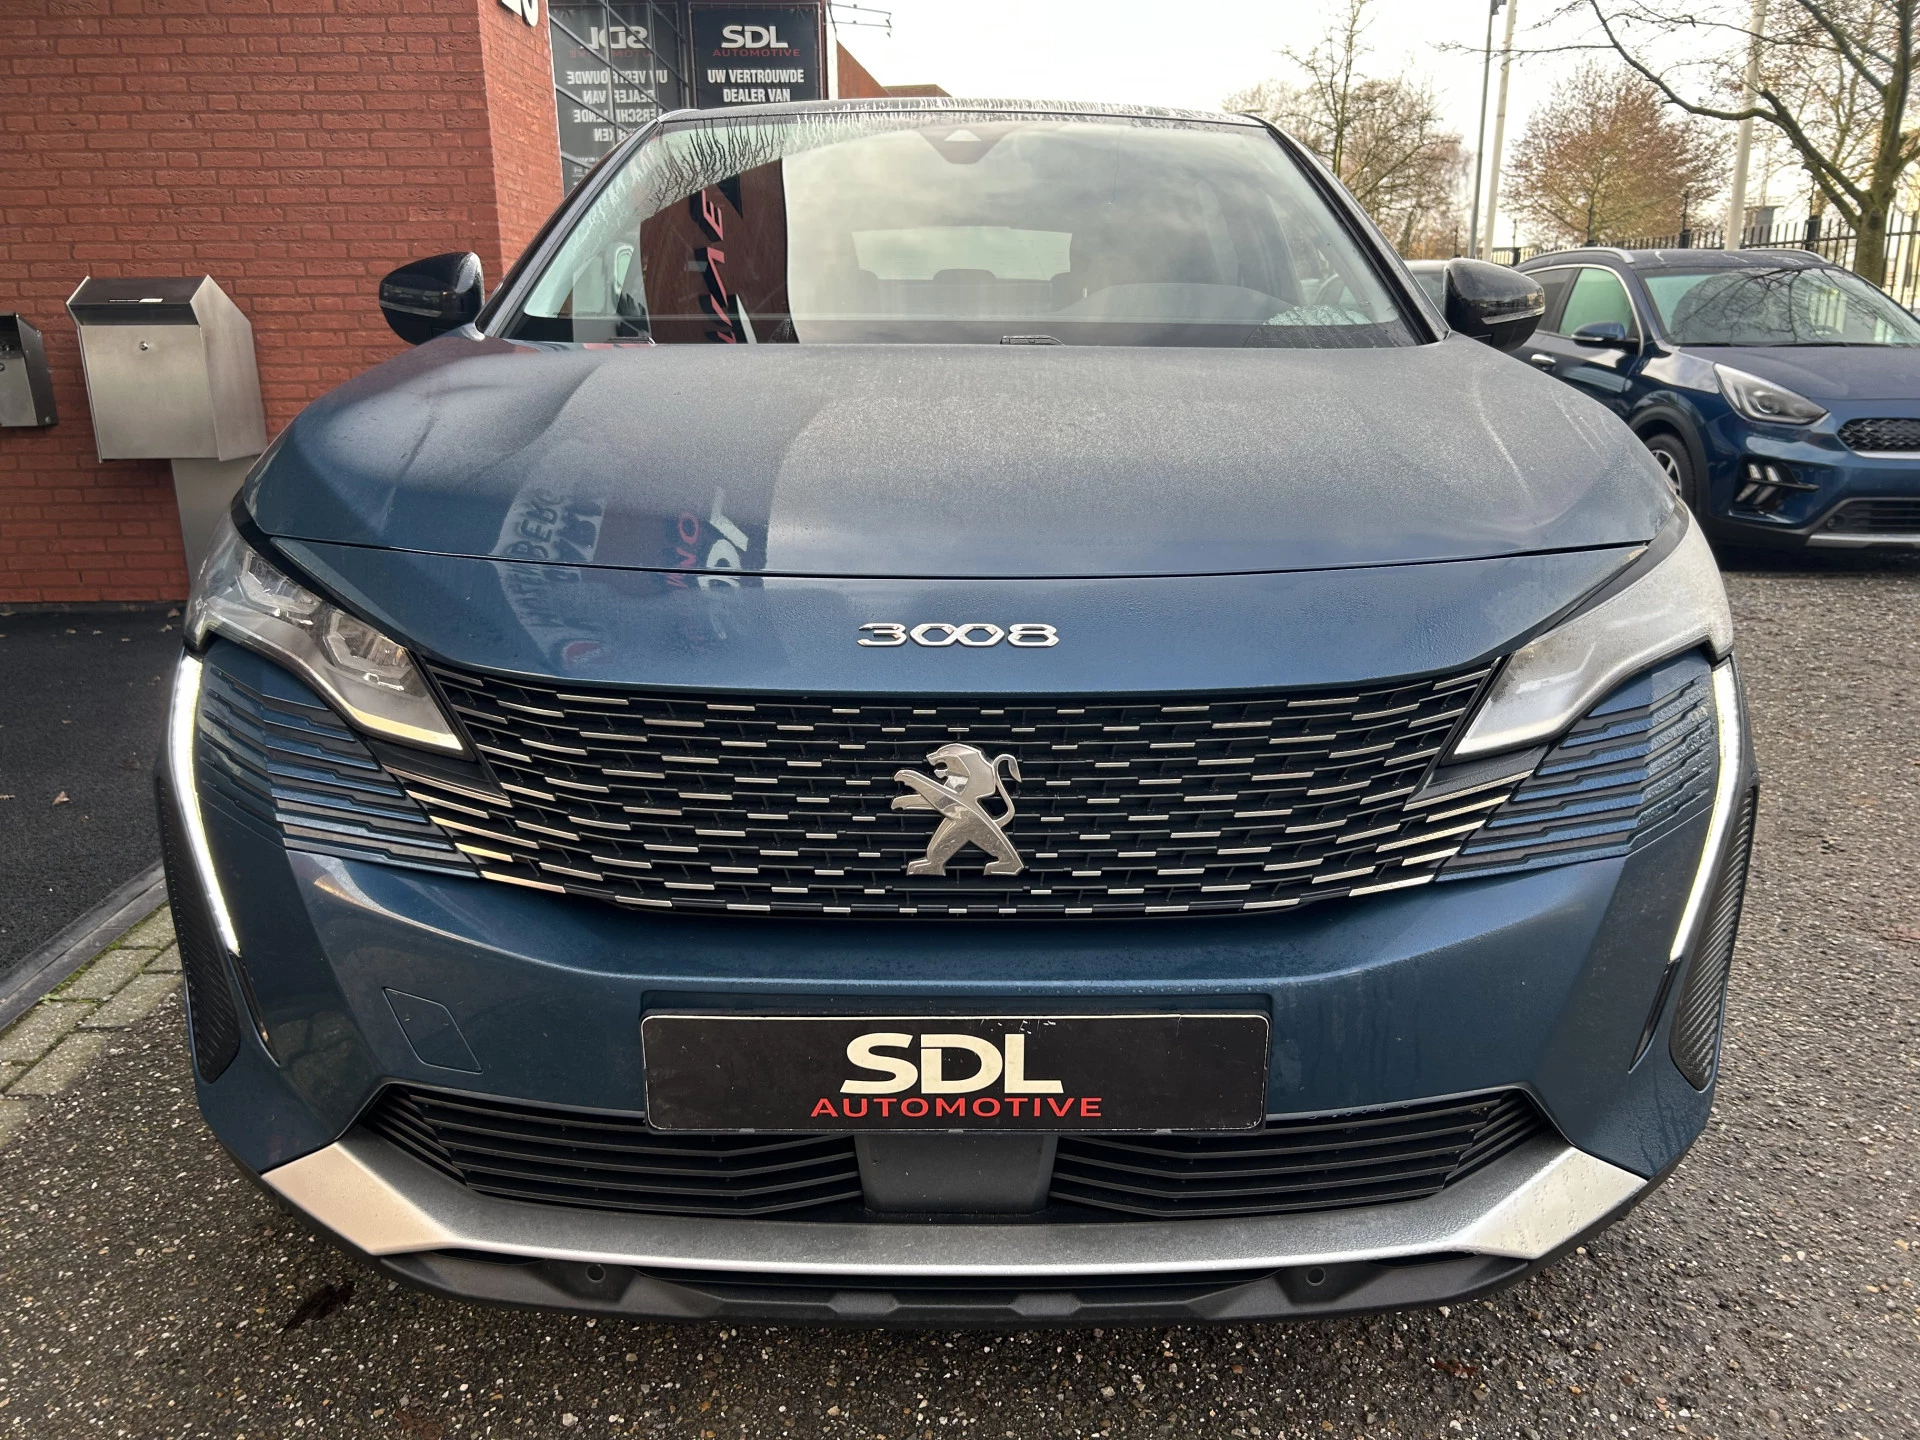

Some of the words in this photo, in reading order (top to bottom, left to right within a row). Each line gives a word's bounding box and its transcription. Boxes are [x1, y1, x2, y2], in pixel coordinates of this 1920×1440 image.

[720, 25, 789, 49] SDL
[712, 48, 801, 57] AUTOMOTIVE
[707, 69, 726, 84] UW
[728, 69, 805, 84] VERTROUWDE
[722, 88, 766, 103] DEALER
[767, 88, 791, 103] VAN
[857, 623, 1060, 647] 3008
[839, 1032, 1064, 1095] SDL
[810, 1097, 1102, 1118] AUTOMOTIVE
